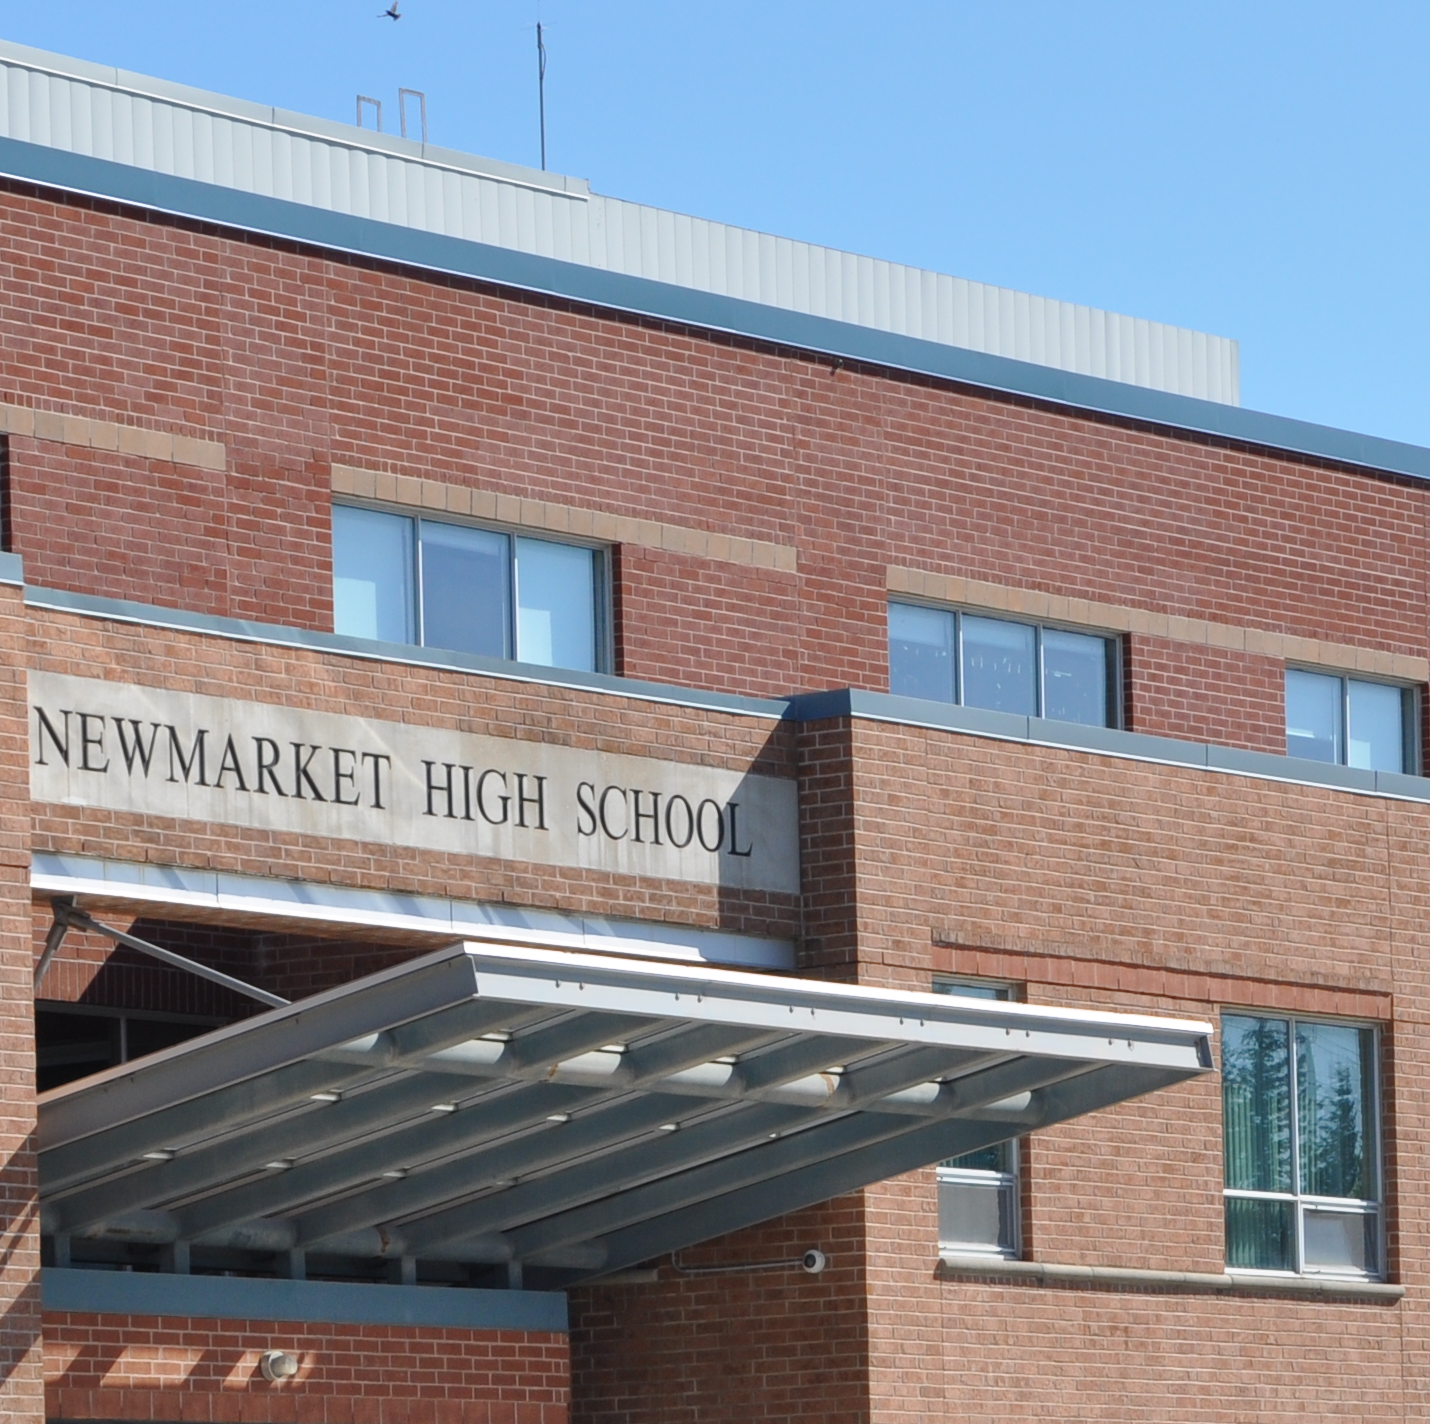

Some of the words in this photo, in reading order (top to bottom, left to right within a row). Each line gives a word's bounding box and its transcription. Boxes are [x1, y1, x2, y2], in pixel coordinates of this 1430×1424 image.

[33, 705, 392, 810] NEWMARKET
[421, 760, 549, 831] HIGH
[576, 781, 753, 857] SCHOOL
